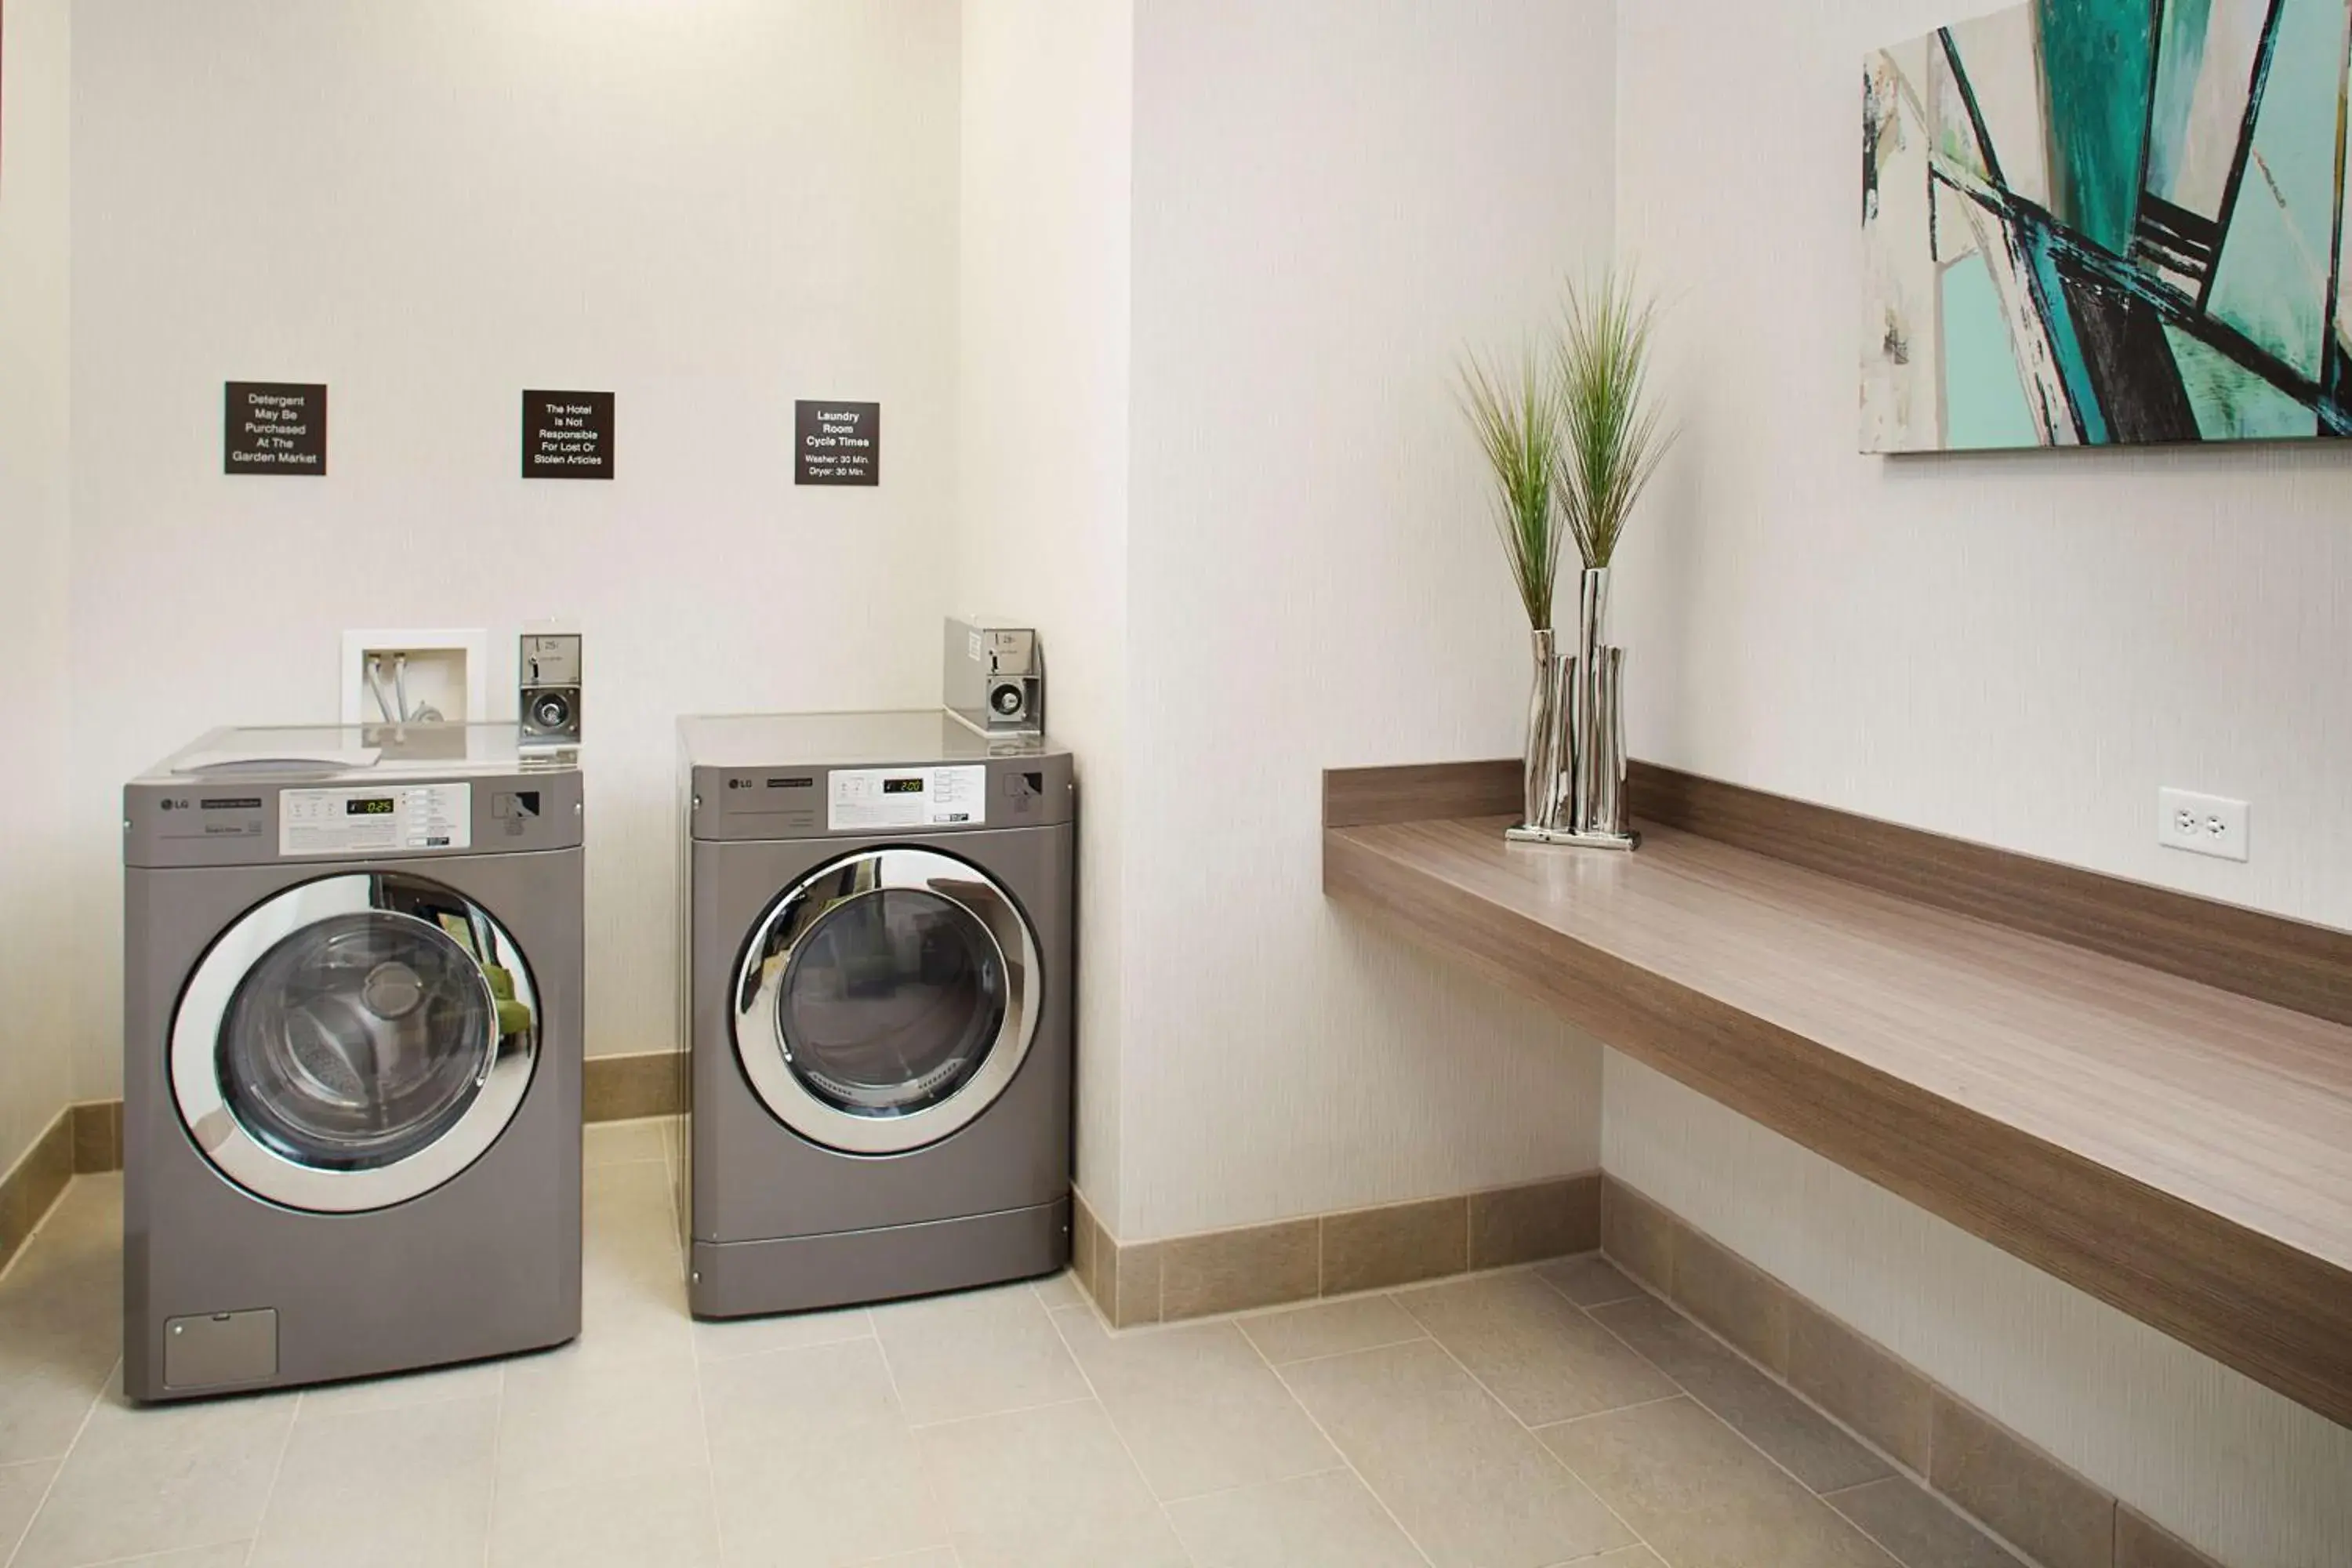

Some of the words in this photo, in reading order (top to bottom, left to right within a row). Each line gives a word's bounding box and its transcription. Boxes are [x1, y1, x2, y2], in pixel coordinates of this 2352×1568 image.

[249, 394, 304, 408] Detergent
[255, 408, 278, 421] May
[281, 409, 297, 420] Be
[546, 404, 564, 414] The
[566, 405, 592, 415] Hotel
[554, 417, 563, 426] Is
[565, 417, 583, 426] Not
[817, 410, 859, 423] Laundry
[245, 422, 307, 435] Purchased
[822, 423, 854, 434] Room
[539, 429, 597, 440] Responsible
[256, 437, 269, 448] At
[271, 437, 294, 448] The
[542, 441, 557, 451] For
[561, 443, 580, 452] Lost
[583, 443, 596, 452] Or
[806, 436, 836, 448] Cycle
[838, 437, 869, 447] Times
[232, 451, 274, 463] Garden
[278, 453, 317, 463] Market
[534, 454, 564, 464] Stolen
[567, 456, 602, 465] Articles
[835, 467, 847, 476] 30
[739, 779, 753, 788] LG
[175, 799, 189, 809] LG
